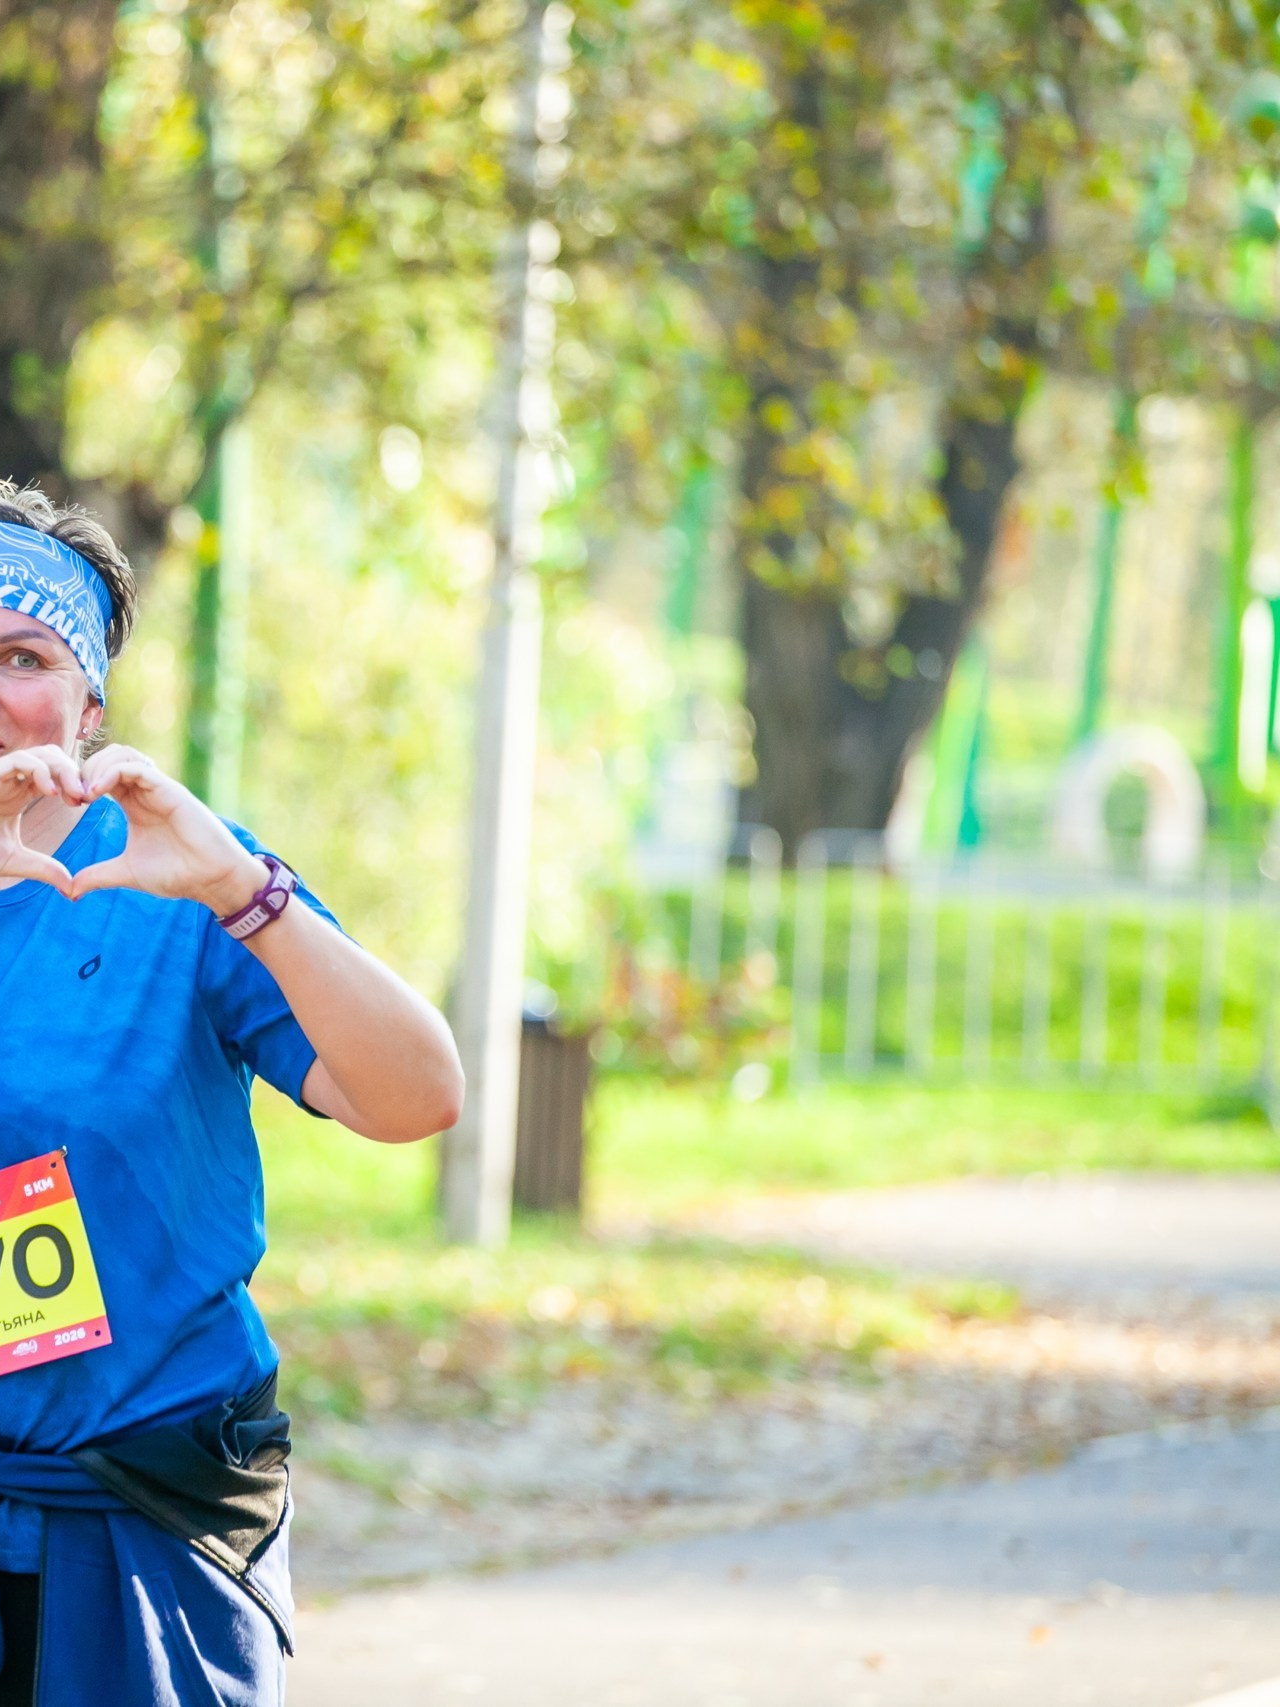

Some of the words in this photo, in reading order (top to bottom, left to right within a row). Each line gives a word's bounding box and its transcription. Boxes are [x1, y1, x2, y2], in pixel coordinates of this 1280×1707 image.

[36, 575, 64, 598] MY
[23, 1183, 34, 1197] 5
[33, 1176, 55, 1194] КМ
[54, 1327, 86, 1346] 2026
